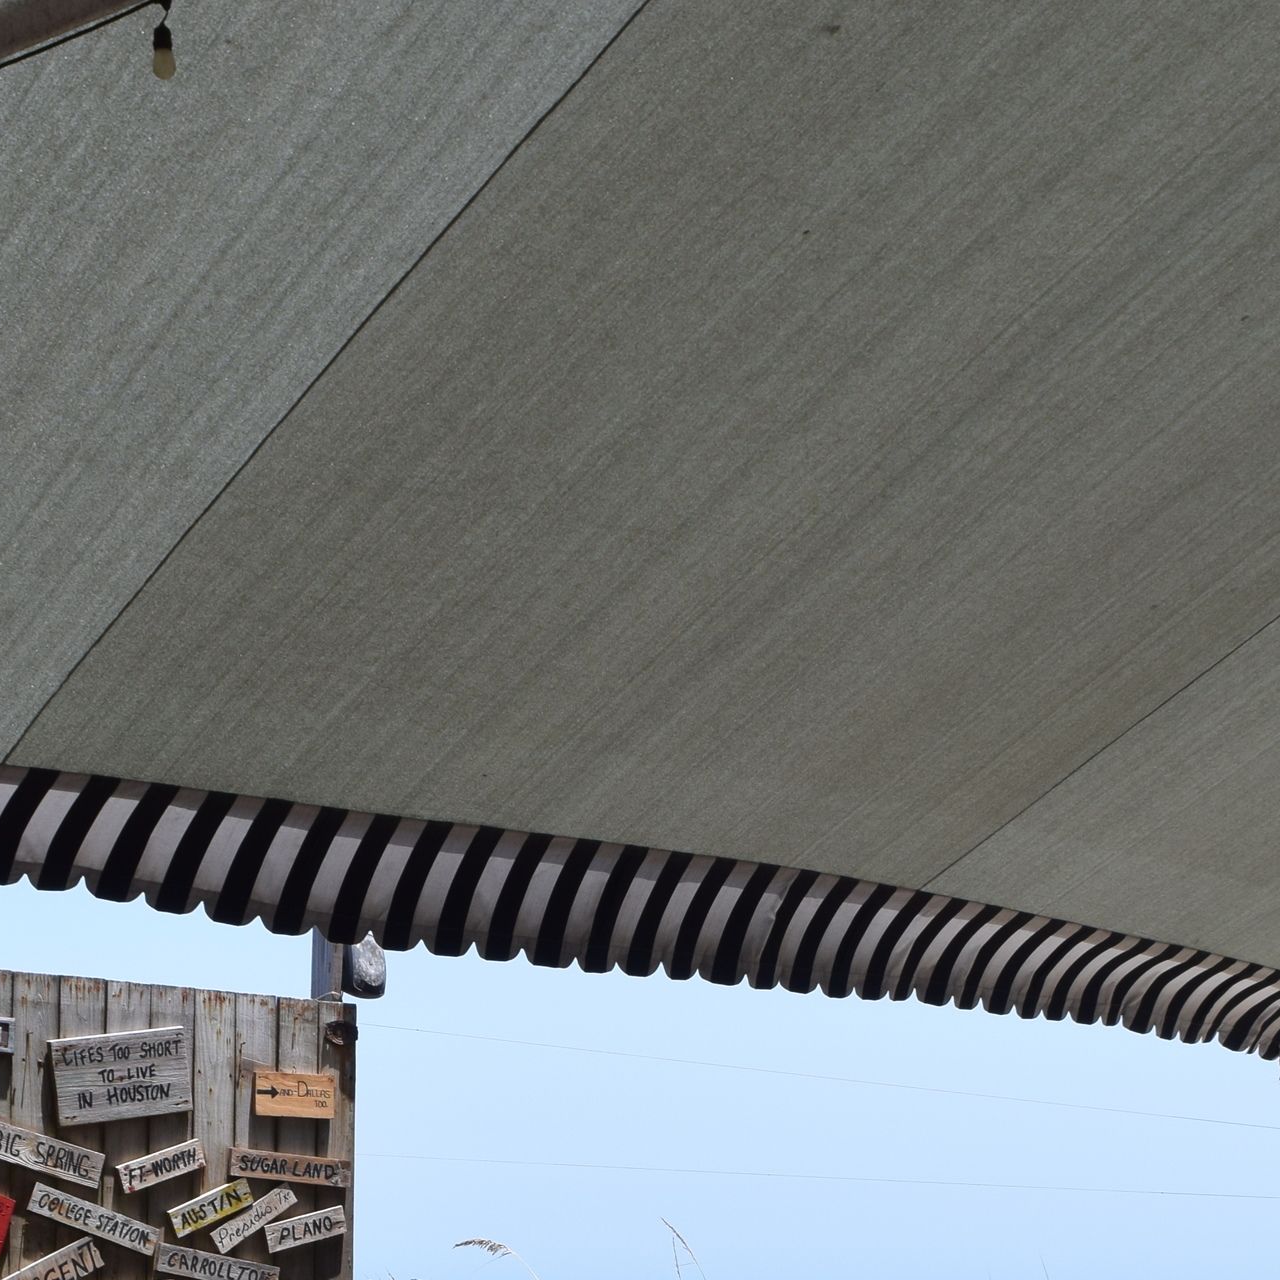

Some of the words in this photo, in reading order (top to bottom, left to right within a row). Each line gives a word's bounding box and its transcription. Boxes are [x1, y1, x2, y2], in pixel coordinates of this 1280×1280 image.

[108, 1044, 130, 1061] TOO
[139, 1040, 182, 1058] SHORT
[99, 1069, 114, 1083] TO
[127, 1063, 156, 1080] LIVE
[78, 1092, 92, 1109] IN
[107, 1083, 171, 1104] HOUSTON
[34, 1142, 90, 1178] SPRING
[239, 1155, 287, 1175] SUGAR
[292, 1161, 335, 1179] LAND
[38, 1192, 93, 1225] COLLEGE
[96, 1214, 150, 1247] STATION
[181, 1188, 242, 1229] AUSTIN
[279, 1216, 333, 1245] PLANO
